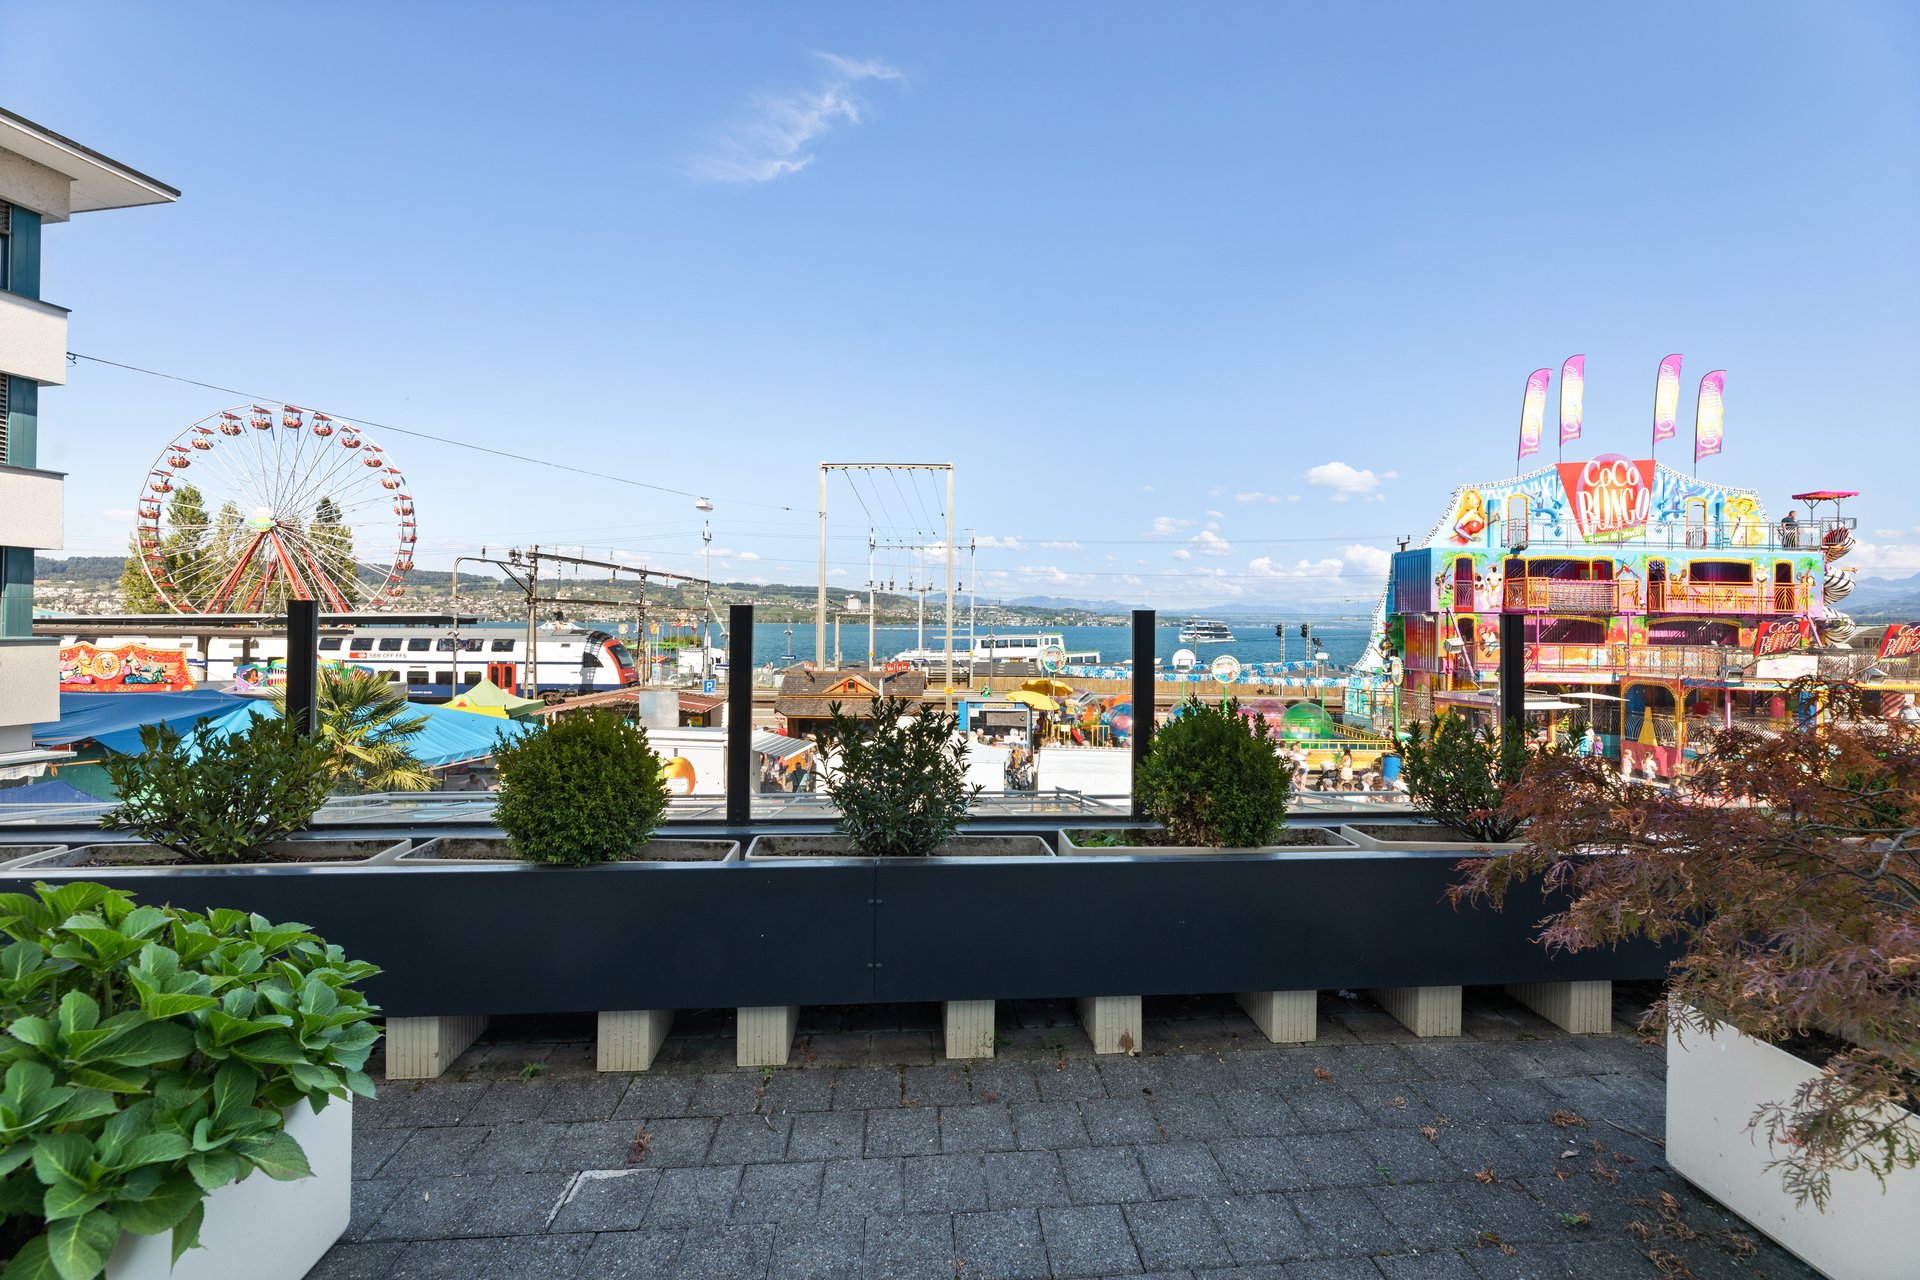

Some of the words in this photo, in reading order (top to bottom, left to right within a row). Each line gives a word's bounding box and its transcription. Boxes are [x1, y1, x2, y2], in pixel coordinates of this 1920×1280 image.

[1584, 460, 1640, 487] CoCo
[1577, 485, 1650, 536] BONGO
[1769, 621, 1799, 633] CoCo
[706, 681, 713, 691] P
